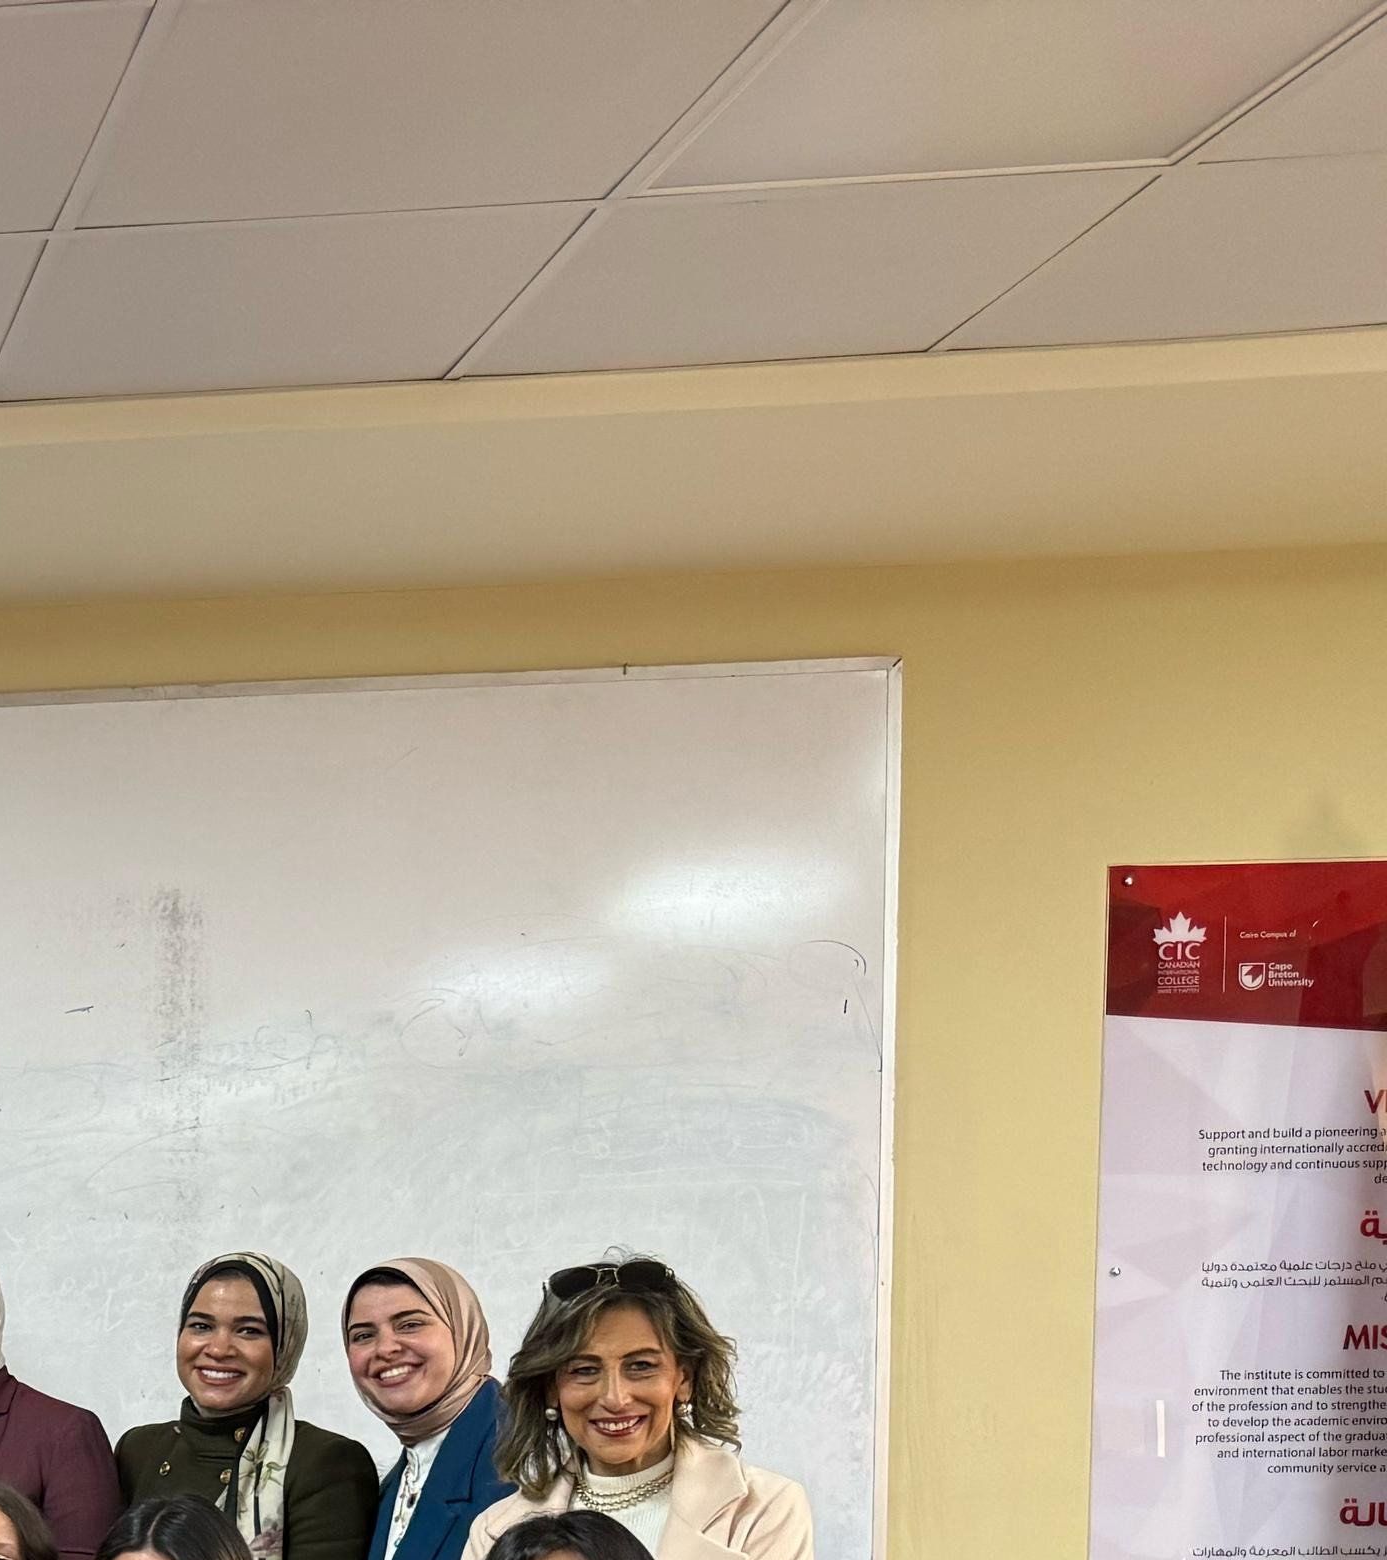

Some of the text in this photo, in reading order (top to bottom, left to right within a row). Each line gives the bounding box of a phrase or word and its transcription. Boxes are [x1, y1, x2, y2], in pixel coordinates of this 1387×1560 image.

[1158, 942, 1201, 961] CIC
[1158, 960, 1200, 969] CANADIAN
[1268, 962, 1293, 971] Cape
[1268, 970, 1300, 978] Breton
[1158, 976, 1200, 985] COLLEGE
[1268, 978, 1314, 988] University
[1199, 1130, 1245, 1141] Support
[1248, 1128, 1270, 1138] and
[1274, 1128, 1302, 1138] build
[1315, 1127, 1378, 1139] pioneering
[1209, 1146, 1257, 1158] granting
[1261, 1142, 1344, 1155] internationally
[1203, 1160, 1268, 1173] technology
[1271, 1159, 1292, 1169] and
[1295, 1160, 1361, 1169] continuous
[1202, 1262, 1228, 1273] دوليا
[1280, 1260, 1313, 1271] علمية
[1316, 1261, 1353, 1271] درجات
[1324, 1275, 1370, 1287] المستمر
[1220, 1368, 1385, 1380] The institute is committed to
[1194, 1386, 1267, 1396] environment
[1272, 1385, 1294, 1395] that
[1298, 1384, 1342, 1395] enables
[1346, 1384, 1364, 1394] the
[1192, 1401, 1203, 1411] of
[1207, 1402, 1225, 1411] the
[1229, 1401, 1287, 1413] profession
[1291, 1400, 1312, 1410] and
[1317, 1402, 1328, 1410] to
[1208, 1419, 1219, 1427] to
[1223, 1417, 1269, 1428] develop
[1273, 1417, 1291, 1426] the
[1294, 1414, 1350, 1426] academic
[1196, 1432, 1264, 1445] professional
[1268, 1433, 1305, 1444] aspect
[1309, 1431, 1320, 1441] of
[1323, 1432, 1342, 1441] the
[1218, 1448, 1238, 1458] and
[1243, 1447, 1315, 1457] international
[1319, 1447, 1349, 1457] labor
[1268, 1463, 1334, 1475] community
[1338, 1463, 1376, 1472] service
[1193, 1547, 1246, 1558] والمهارات
[1249, 1546, 1295, 1557] المعرفة
[1298, 1546, 1338, 1555] الطالب
